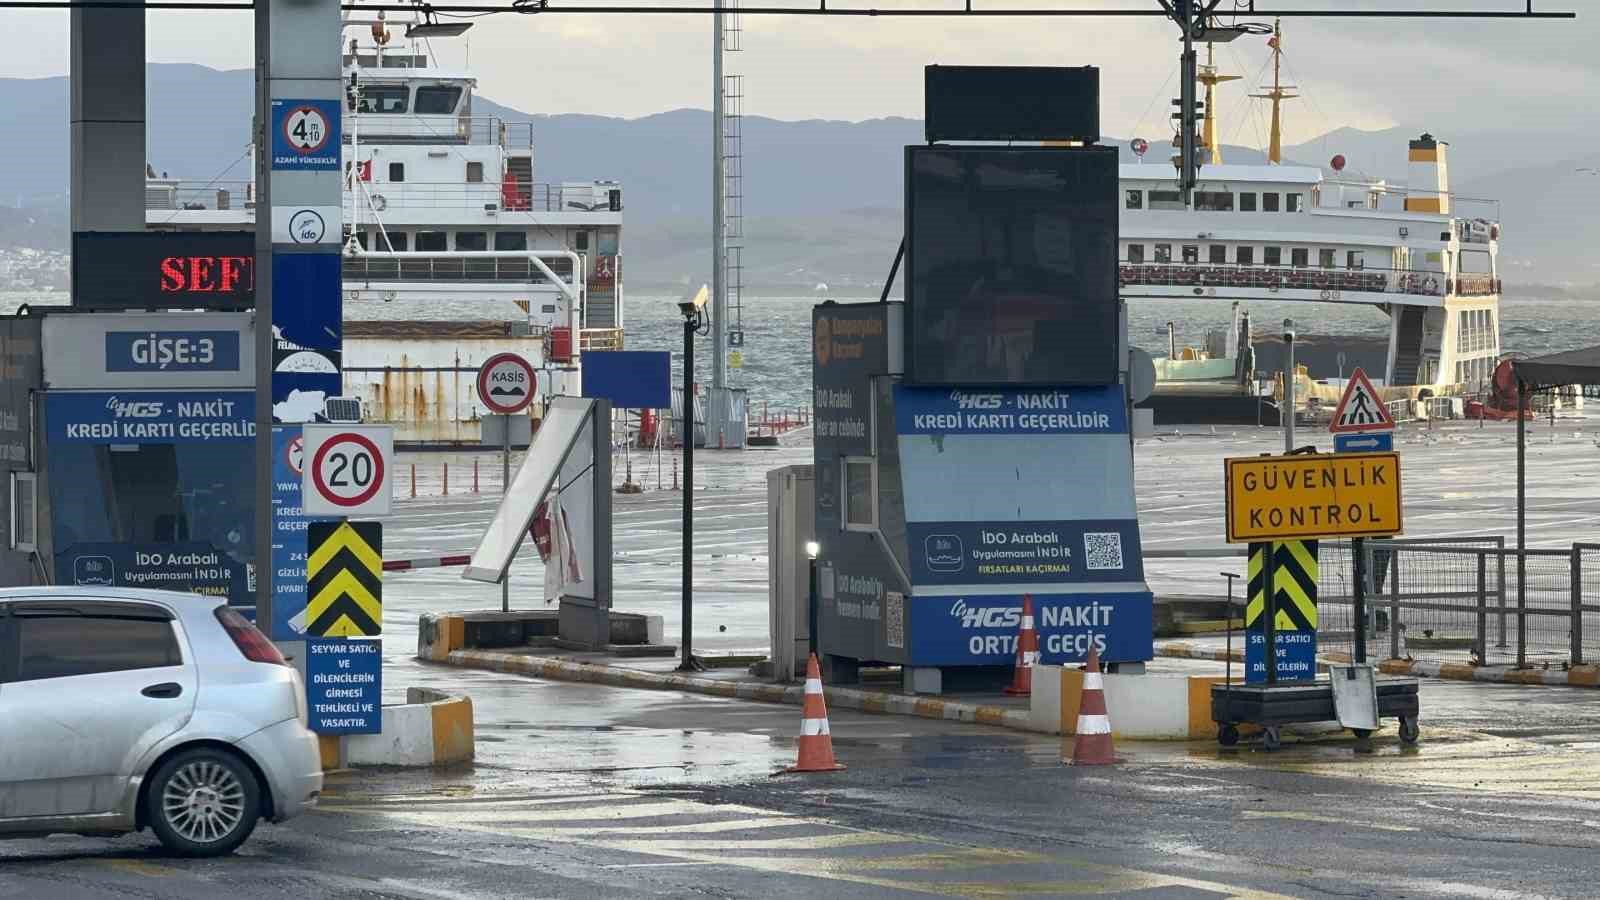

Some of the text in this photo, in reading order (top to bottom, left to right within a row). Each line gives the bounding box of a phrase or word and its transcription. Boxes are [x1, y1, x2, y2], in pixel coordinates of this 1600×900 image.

[292, 118, 307, 141] 4
[301, 230, 317, 240] ido
[160, 255, 256, 293] SEF
[131, 333, 214, 369] GİŞE:3
[491, 370, 525, 383] KASİS
[110, 400, 164, 418] HGS
[177, 398, 235, 418] NAKİT
[957, 394, 1002, 410] HGS
[1017, 391, 1069, 409] NAKİT
[914, 411, 1109, 431] KREDİ KARTI GEÇERLİDİR
[67, 421, 119, 439] KREDİ
[123, 423, 175, 438] KARTI
[329, 452, 372, 487] 20
[1243, 461, 1386, 493] GÜVENLİK
[1250, 503, 1382, 529] KONTROL
[982, 530, 1058, 544] İDO Arabalı
[136, 551, 218, 566] İDO Arabalı
[973, 544, 1072, 560] Uygulamasını İNDİR
[124, 567, 232, 582] Uygulamasını İNDİR
[961, 601, 1114, 628] HGS NAKİT
[311, 644, 347, 654] SEYYAR
[338, 659, 351, 669] VE
[313, 672, 375, 683] DİLENCİLERİN
[325, 687, 363, 698] GİRMESİ
[315, 702, 374, 713] TEHLİKELİ VE
[320, 718, 368, 728] YASAKTIR.
